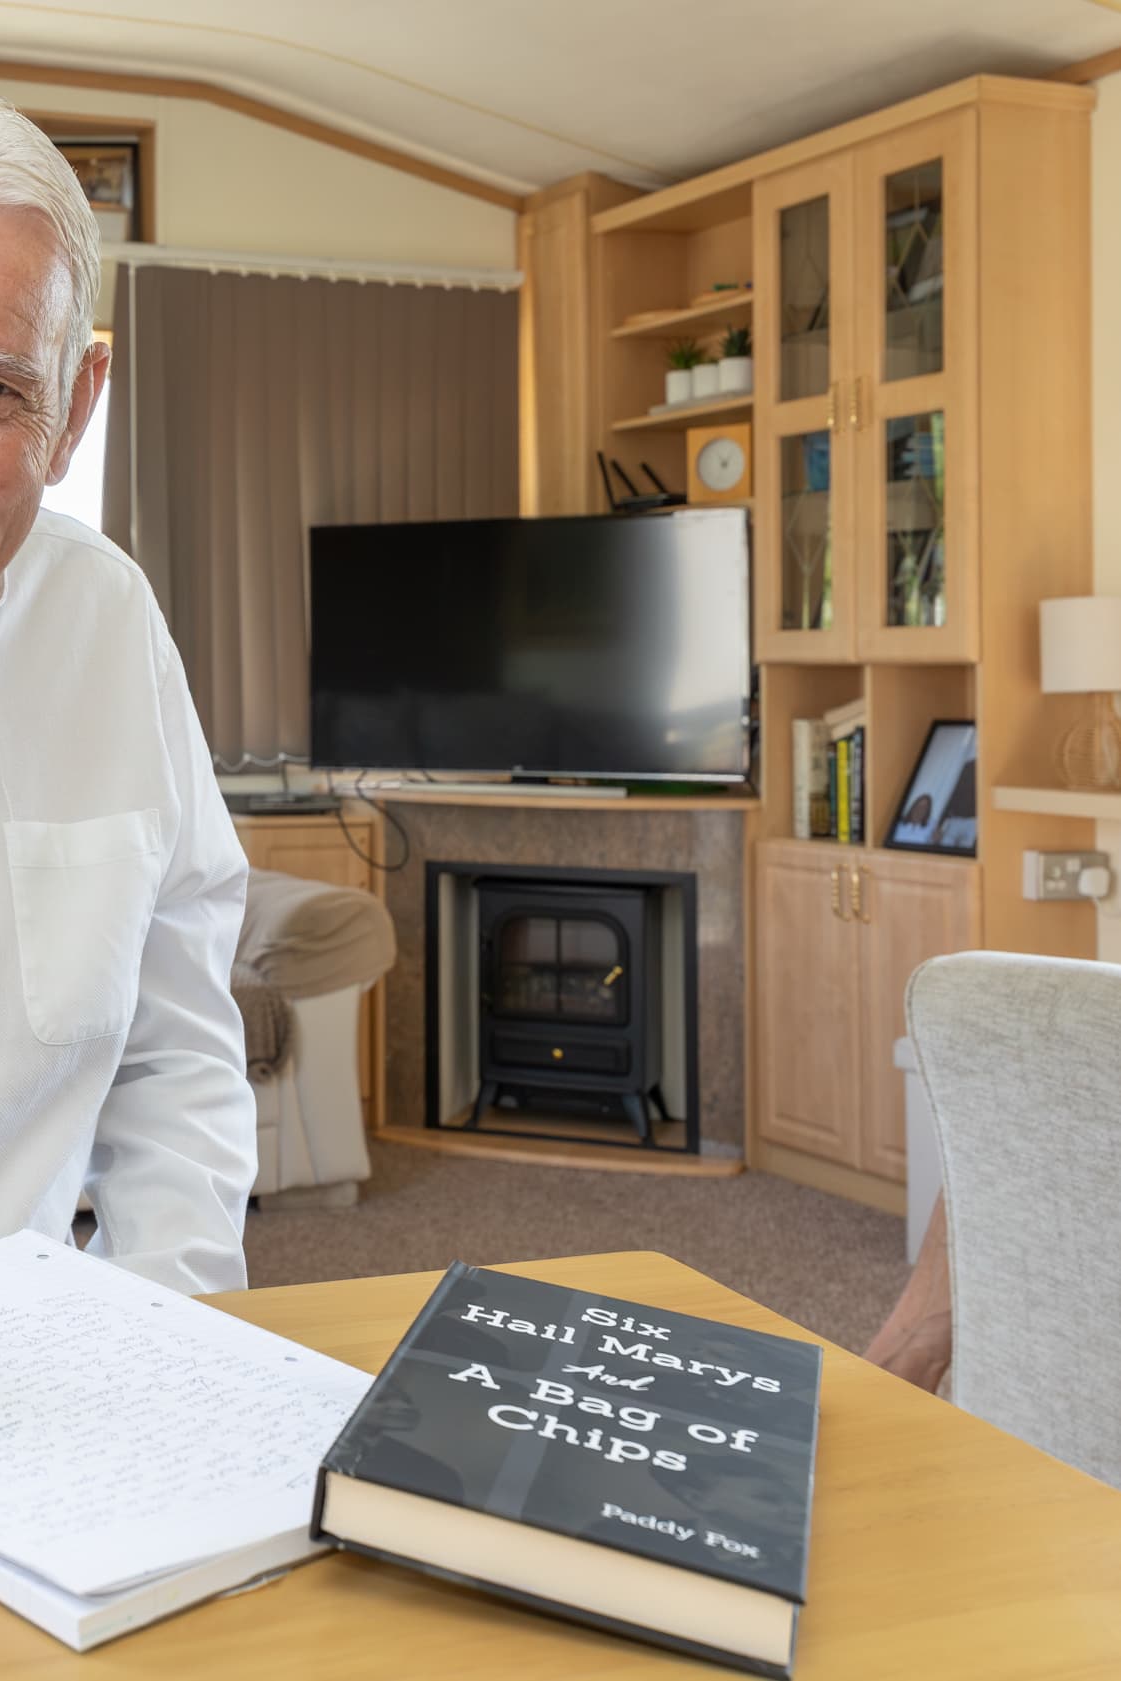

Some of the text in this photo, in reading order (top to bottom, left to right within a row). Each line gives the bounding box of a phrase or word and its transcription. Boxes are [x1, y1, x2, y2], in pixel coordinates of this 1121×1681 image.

[460, 1303, 781, 1393] Hail Marys
[581, 1307, 671, 1341] Six
[447, 1362, 760, 1453] A Bag of
[561, 1363, 656, 1392] And
[487, 1404, 688, 1472] Chips
[601, 1502, 760, 1559] Paddy Fox
